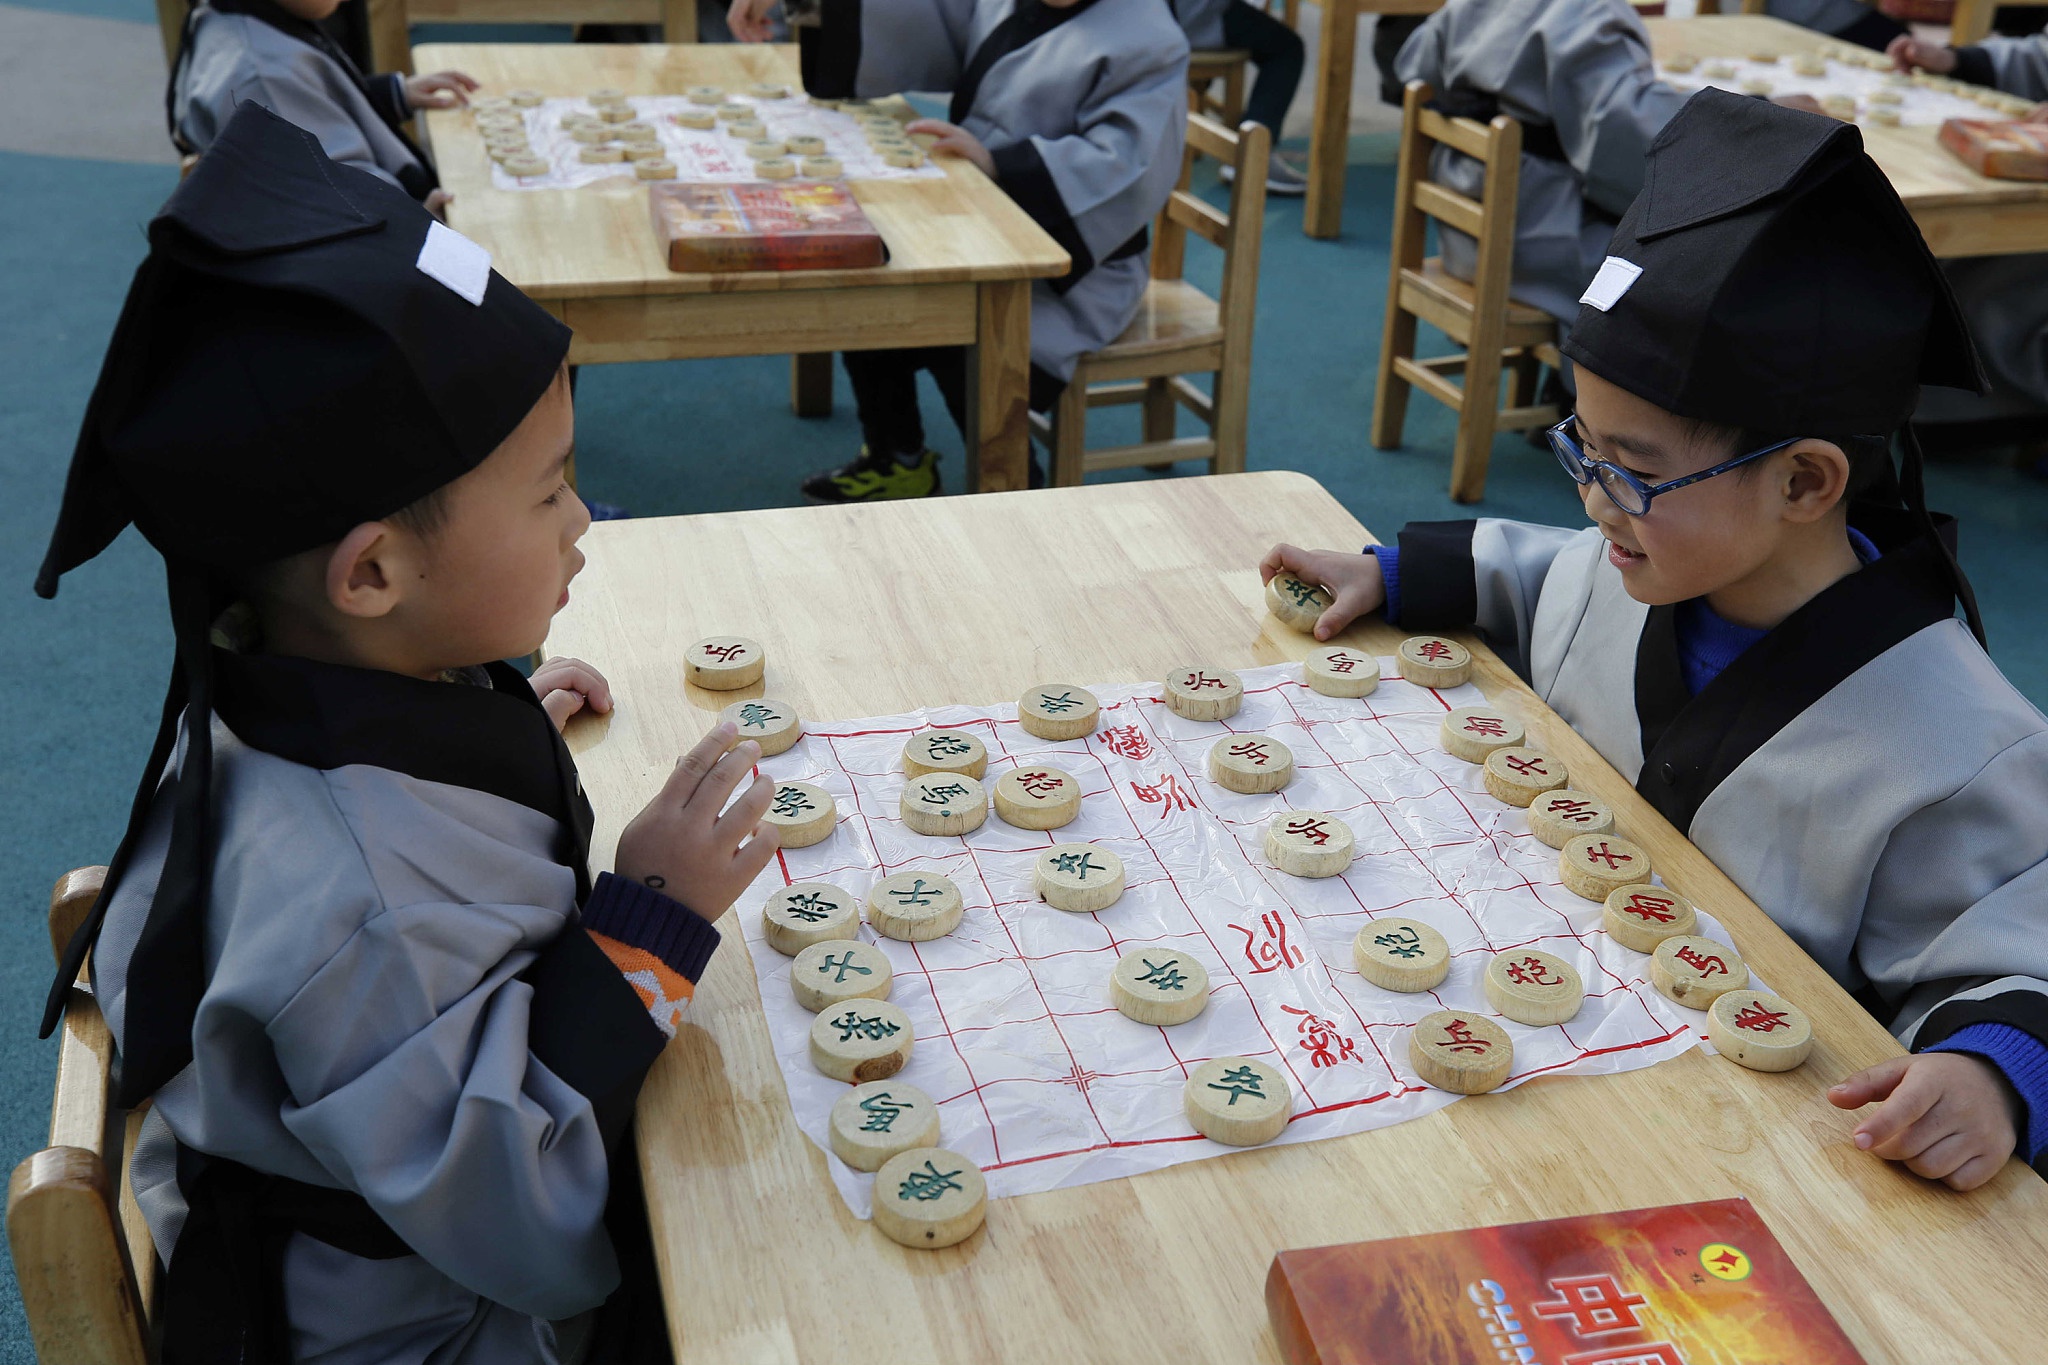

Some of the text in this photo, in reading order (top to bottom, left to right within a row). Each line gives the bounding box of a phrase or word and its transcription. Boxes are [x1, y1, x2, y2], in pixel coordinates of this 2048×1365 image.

[1286, 580, 1320, 607] 卒
[703, 644, 746, 663] 兵
[1184, 671, 1227, 690] 兵
[1040, 691, 1084, 714] 卒
[1464, 717, 1507, 738] 相
[1227, 741, 1270, 766] 兵
[1287, 818, 1331, 846] 兵
[1049, 852, 1107, 880] 卒
[1623, 894, 1676, 924] 相
[1135, 958, 1189, 991] 卒
[1435, 1019, 1494, 1055] 兵
[1207, 1065, 1267, 1106] 卒
